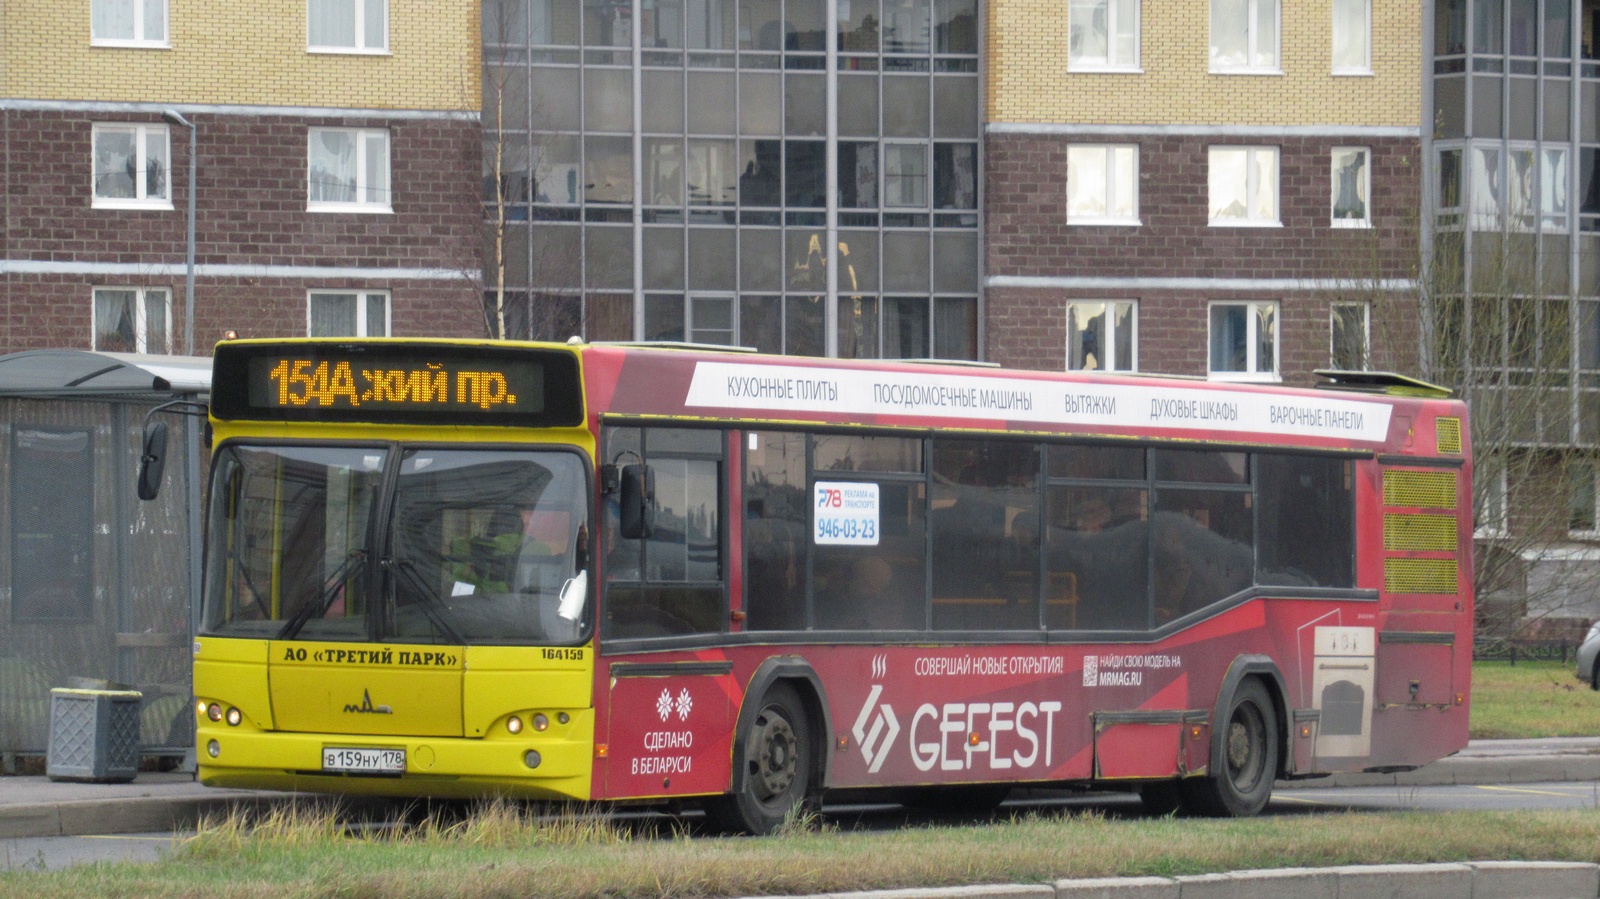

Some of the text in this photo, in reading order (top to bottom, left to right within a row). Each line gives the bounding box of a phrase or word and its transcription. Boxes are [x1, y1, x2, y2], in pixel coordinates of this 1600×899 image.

[270, 360, 360, 406] 154А
[457, 371, 517, 409] пр.
[727, 376, 838, 401] КУХОННЫЕ ПЛИТЫ
[873, 383, 1033, 411] ПОСУДОМОЕЧНЫЕ МАШИНЫ
[1064, 393, 1117, 415] ВЫТЯЖКИ
[1150, 398, 1238, 421] ДУХОВЫЕ ШКАФЫ
[1270, 405, 1364, 431] ВАРОЧНЫЕ ПАНЕЛИ
[818, 517, 875, 539] 946-03-23
[284, 648, 458, 666] АО «ТРЕТИЙ ПАРК»
[541, 648, 584, 661] 164159
[914, 654, 1064, 676] СОВЕРШАЙ НОВЫЕ ОТКРЫТИЯ!
[1100, 653, 1181, 669] НАЙДИ СВОЮ МОДЕЛЬ НА
[1100, 671, 1142, 686] MRMAG.RU
[644, 731, 693, 752] СДЕЛАНО
[909, 701, 1062, 772] GEFEST
[382, 751, 402, 765] 178
[632, 756, 691, 775] В БЕЛАРУСИ
